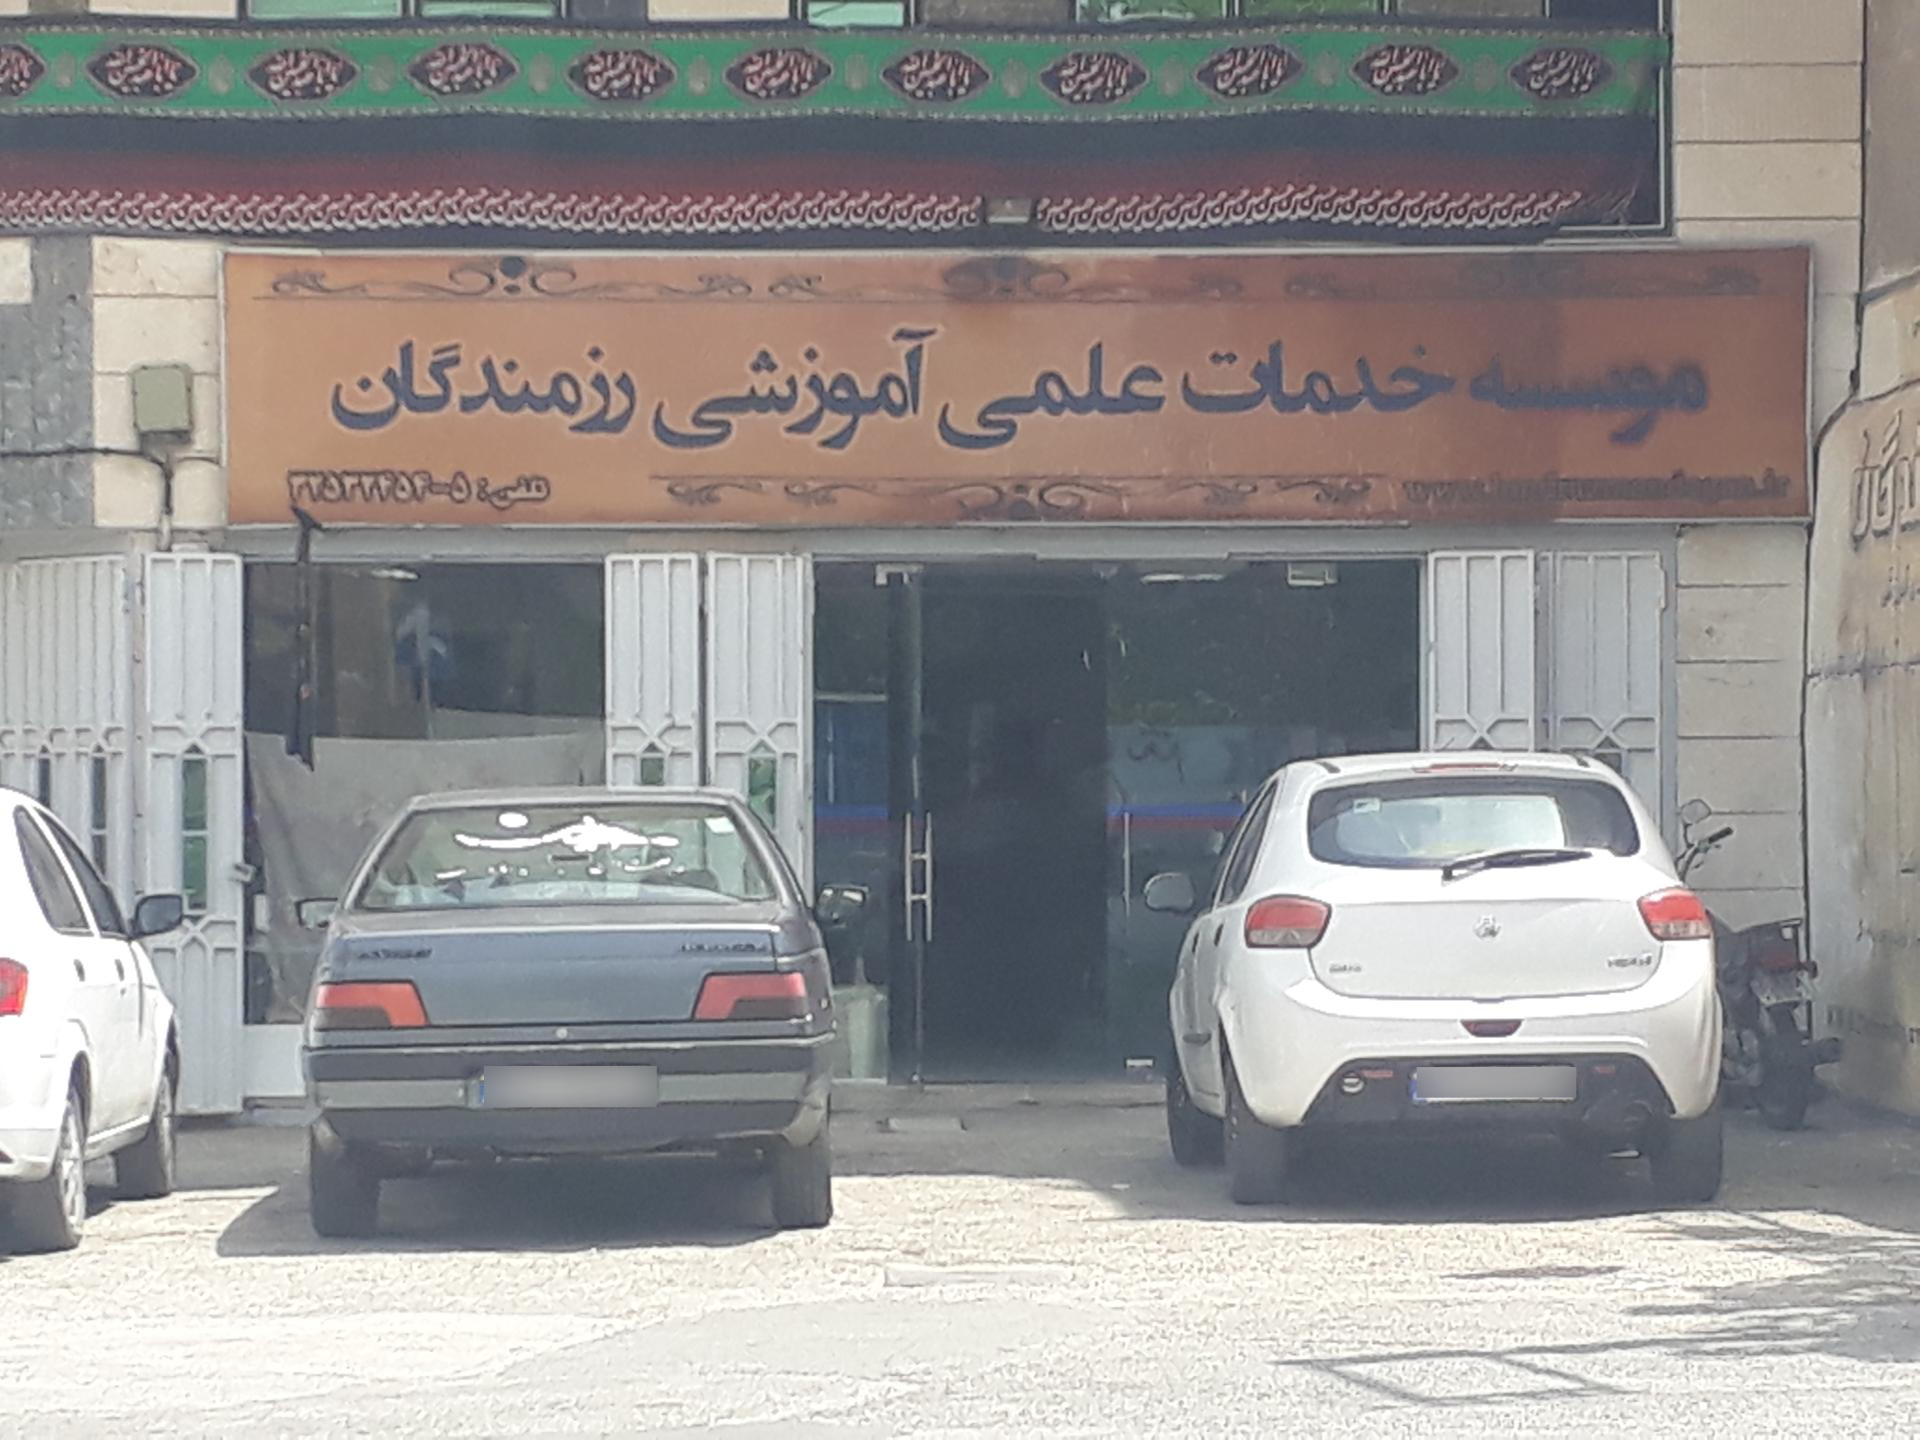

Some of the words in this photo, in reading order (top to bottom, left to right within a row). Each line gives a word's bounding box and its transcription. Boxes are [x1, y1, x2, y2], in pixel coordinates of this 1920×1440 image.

[331, 339, 637, 432] رزمندگان
[653, 327, 936, 449] آموزشی
[937, 341, 1167, 450] علمی
[1181, 339, 1456, 414] خدمات
